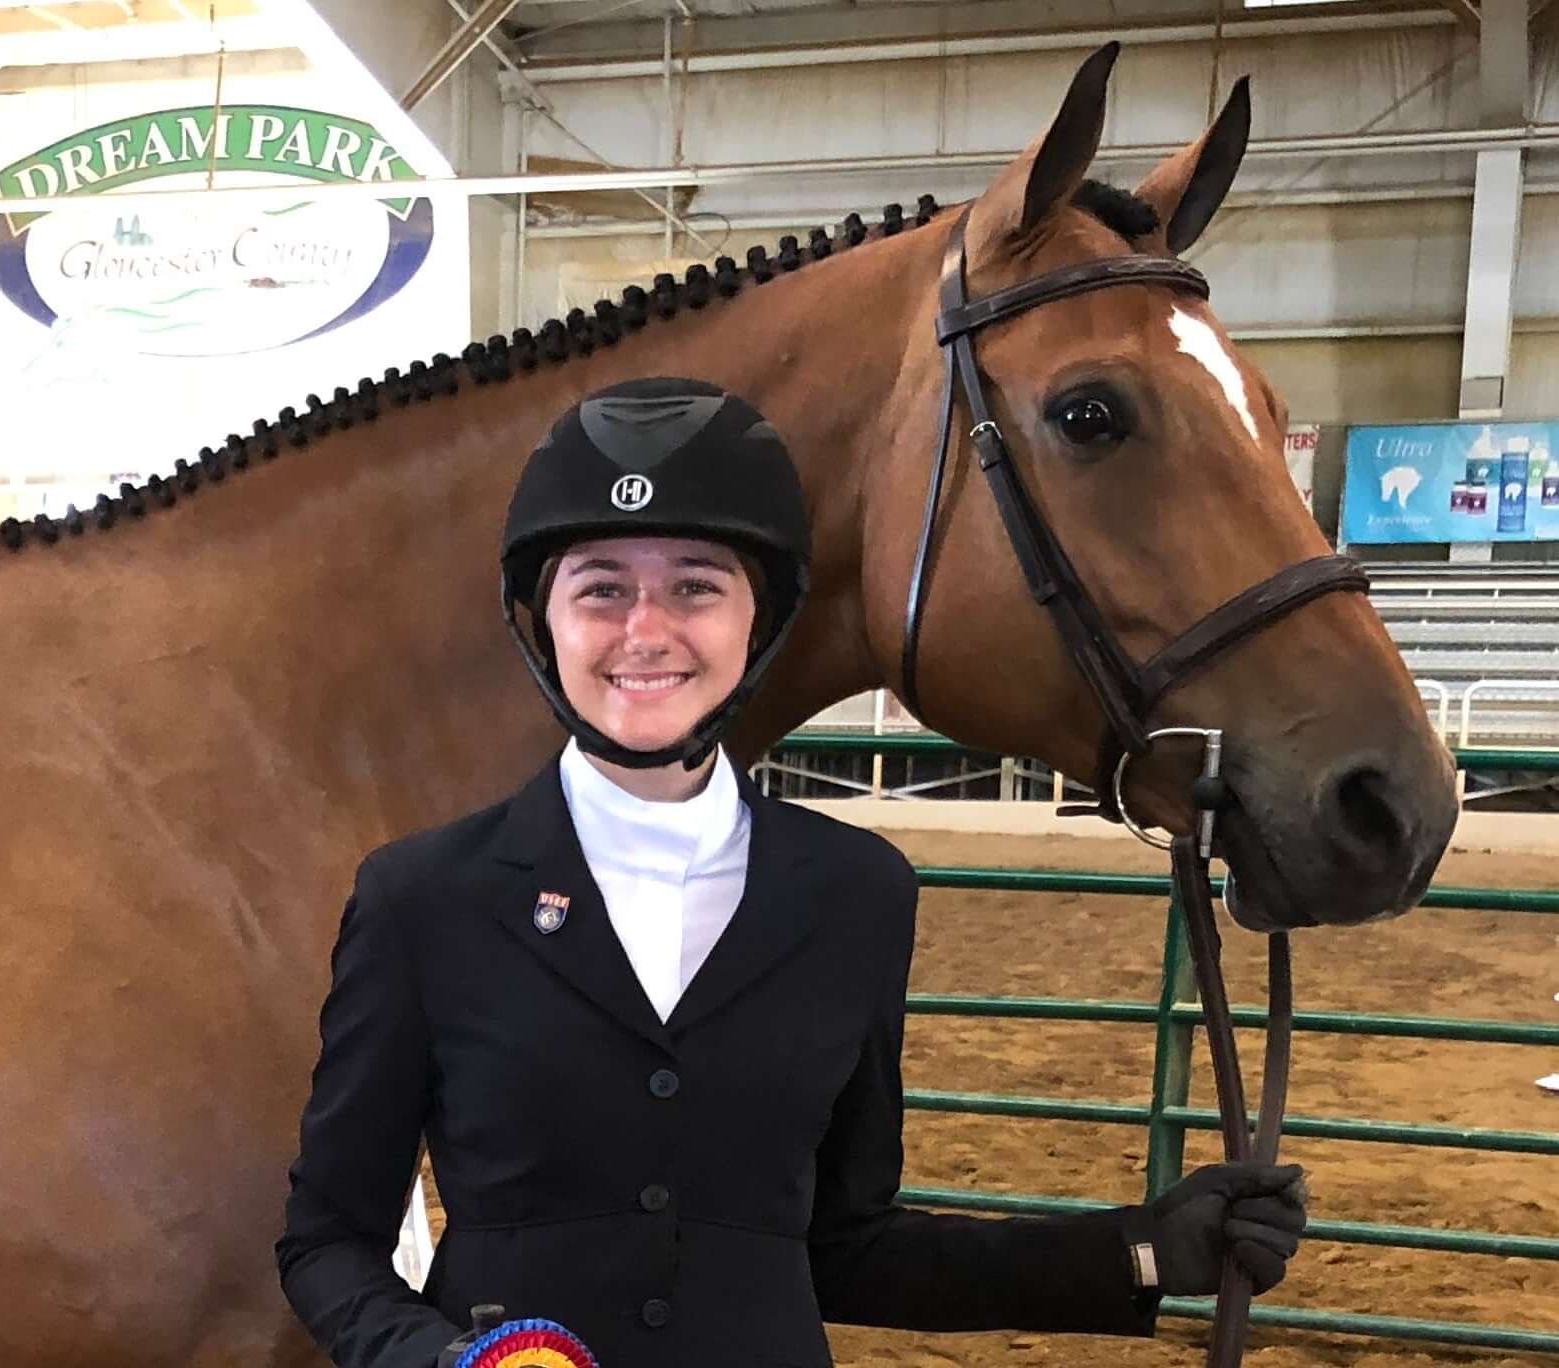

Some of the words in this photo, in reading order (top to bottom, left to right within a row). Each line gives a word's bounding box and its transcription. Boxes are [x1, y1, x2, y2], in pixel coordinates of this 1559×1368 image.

[14, 113, 233, 198] DREAM
[244, 112, 408, 182] PARK
[59, 240, 222, 281] Gloucester
[1375, 437, 1434, 458] Ultra
